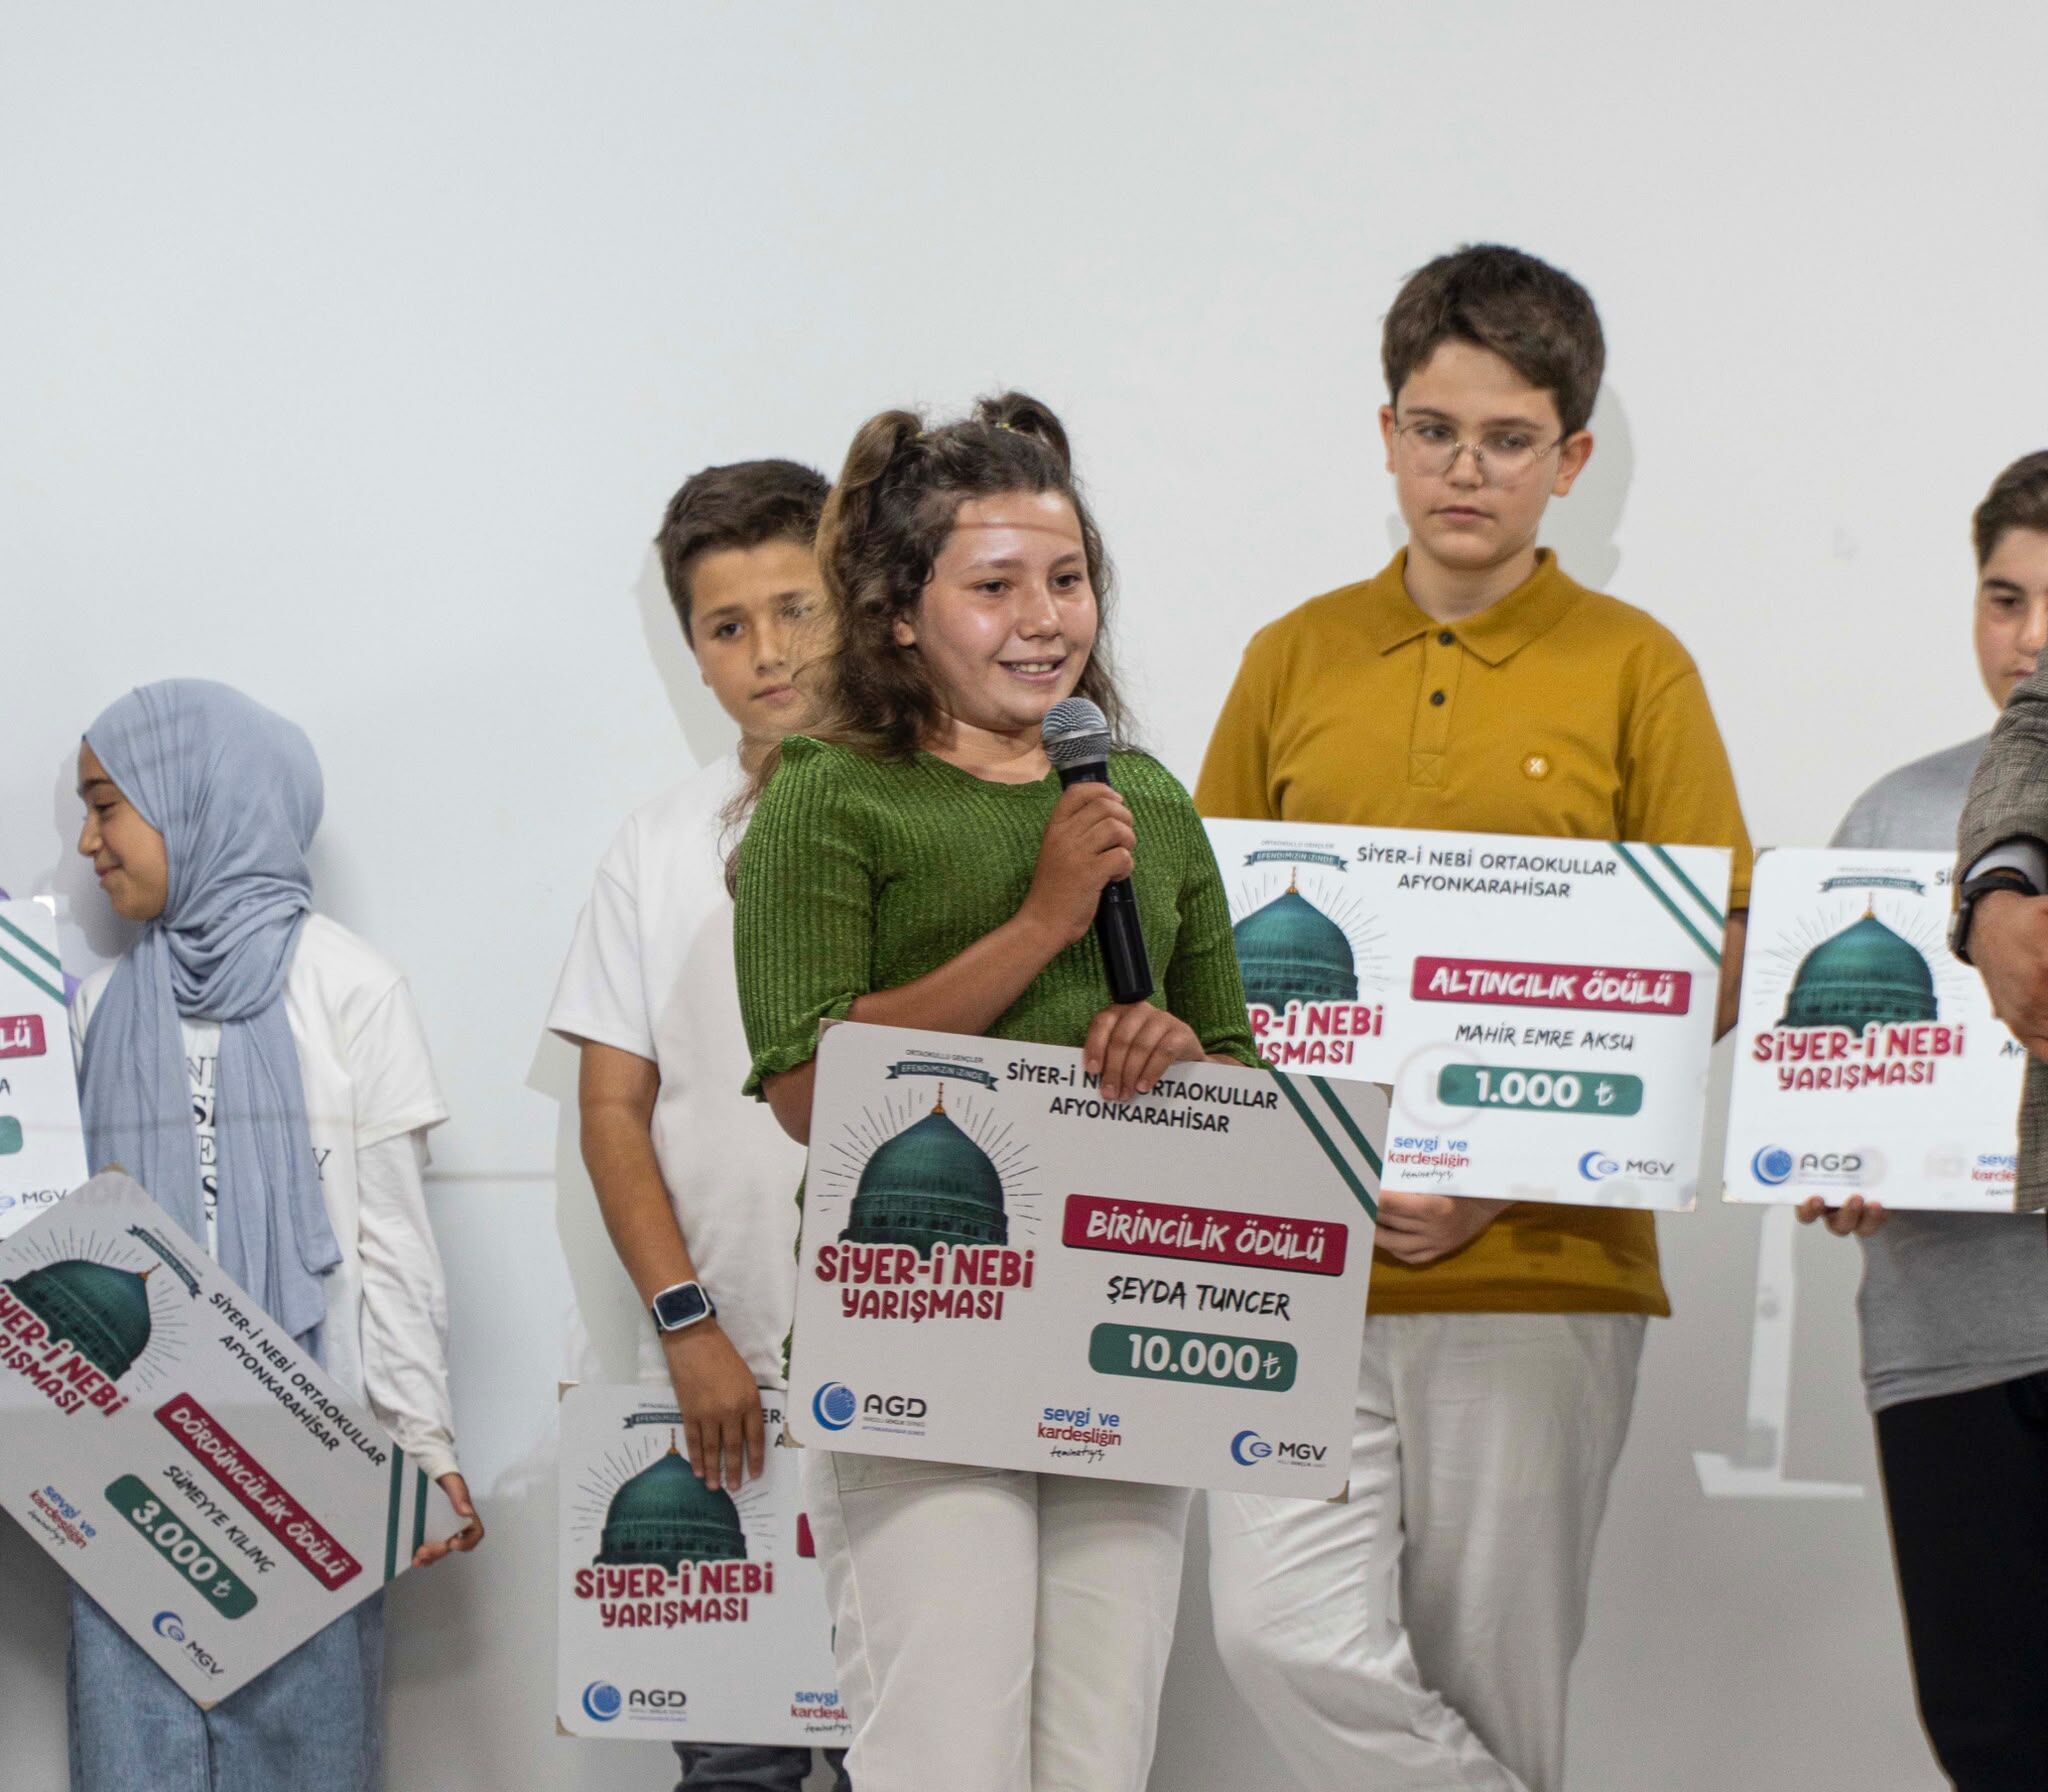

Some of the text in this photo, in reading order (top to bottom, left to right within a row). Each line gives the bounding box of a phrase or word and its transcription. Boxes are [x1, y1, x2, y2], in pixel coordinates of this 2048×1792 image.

[1357, 843, 1617, 876] SİYER-İ NEBİ ORTAOKULLAR
[1397, 874, 1570, 897] AFYONKARAHİSAR
[1429, 966, 1675, 1006] ALTINCILIK ÖDÜLÜ
[1455, 1022, 1634, 1051] MAHİR EMRE AKSU
[1006, 1058, 1076, 1087] SİYER-İ
[1136, 1079, 1278, 1110] RTAOKULLAR
[1475, 1070, 1580, 1108] 1.000
[1778, 1061, 1935, 1091] YARIŞMASI
[1049, 1096, 1230, 1133] AFYONKARAHİSAR
[1394, 1135, 1468, 1152] sevgi ve
[1388, 1151, 1470, 1168] kardeşliğin
[1626, 1160, 1675, 1176] MGV
[1800, 1153, 1862, 1172] AGD
[21, 1189, 67, 1204] MGV
[1086, 1205, 1326, 1264] BİRİNCİLİK ÖDÜLÜ
[841, 1288, 1004, 1323] YARIŞMASI
[1107, 1275, 1291, 1321] ŞEYDA TUNCER
[209, 1292, 388, 1467] SİYER-İ NEBİ ORTAOKULLAR
[219, 1335, 340, 1451] AFYONKARAHİSAR
[864, 1394, 927, 1418] AGD
[1043, 1406, 1120, 1427] sevgi ve
[1037, 1422, 1121, 1446] kardeşliğin
[1278, 1441, 1327, 1461] MGV
[170, 1407, 349, 1578] DÖRDÜNCÜLÜK ÖDÜLÜ
[163, 1465, 276, 1574] SÜMEYYE KILINÇ
[132, 1500, 218, 1582] 3.000
[600, 1598, 748, 1629] YARIŞMASI
[186, 1640, 225, 1676] MGV
[629, 1689, 687, 1707] AGD
[795, 1689, 839, 1706] sevgi
